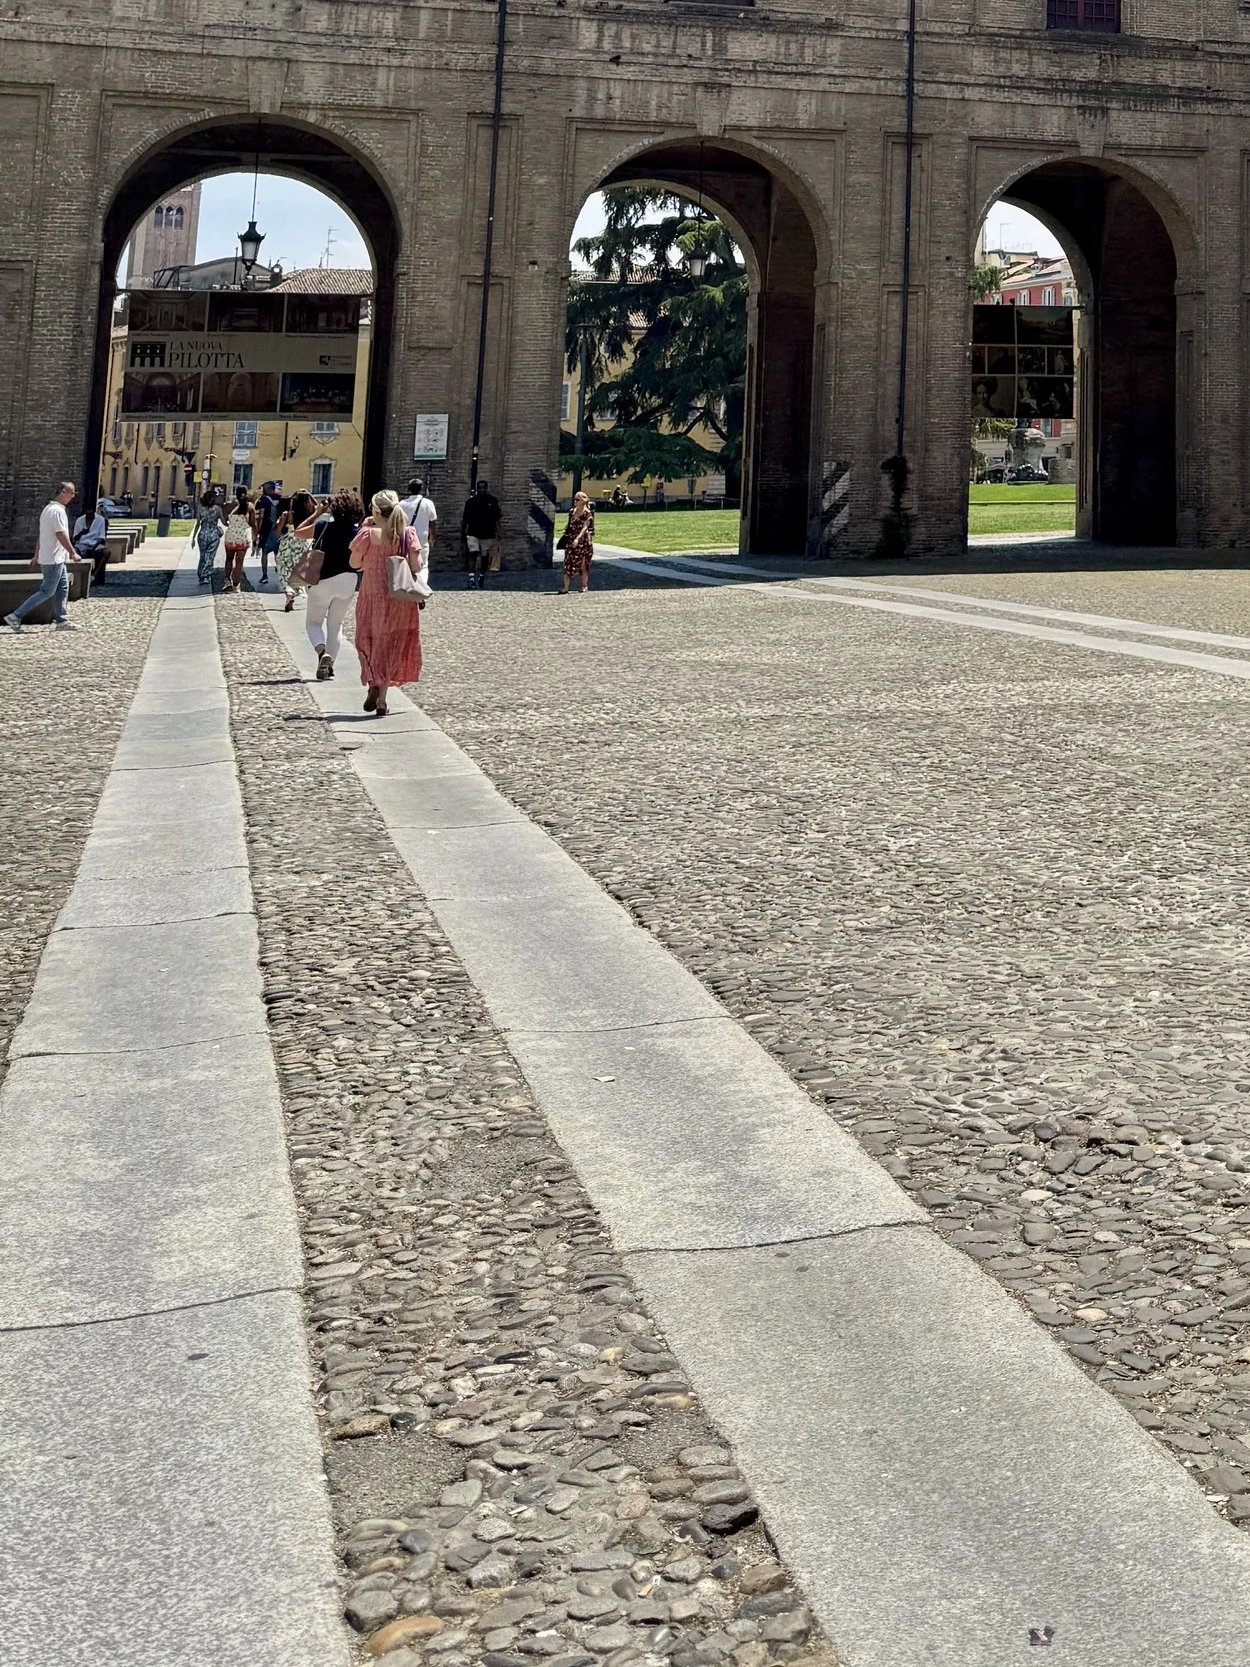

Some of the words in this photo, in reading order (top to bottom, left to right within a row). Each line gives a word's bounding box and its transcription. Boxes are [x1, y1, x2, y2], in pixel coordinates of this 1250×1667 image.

[169, 341, 184, 351] LA
[187, 341, 223, 351] NUOVA
[167, 352, 245, 368] PILOTTA
